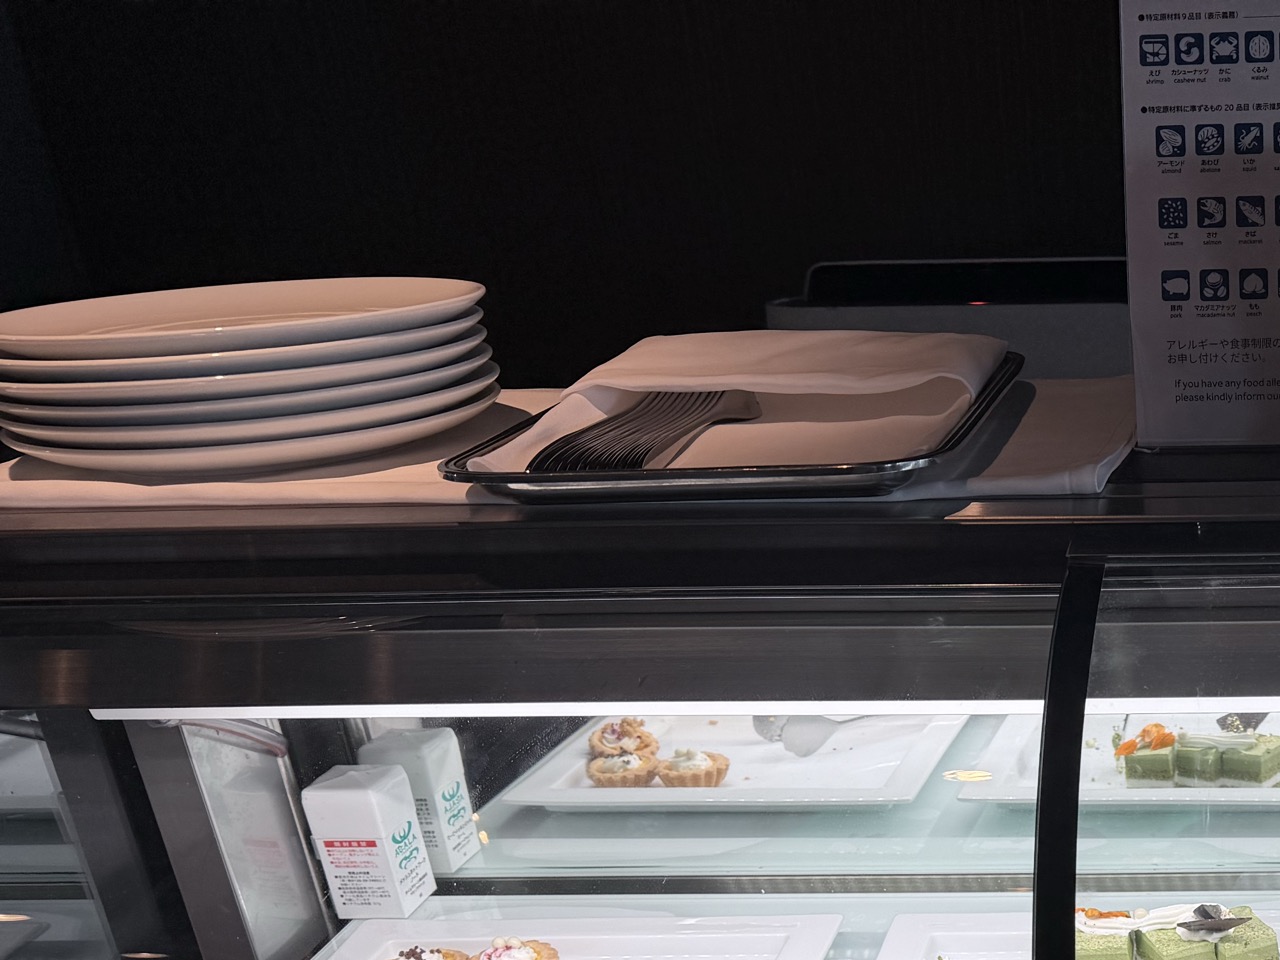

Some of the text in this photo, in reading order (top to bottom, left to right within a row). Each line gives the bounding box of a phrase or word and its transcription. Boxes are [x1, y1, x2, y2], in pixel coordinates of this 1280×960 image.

[1167, 353, 1266, 364] お申し付けください。
[1174, 379, 1182, 388] If
[1182, 381, 1200, 390] you
[1201, 380, 1223, 388] have
[1224, 381, 1242, 390] any
[1243, 378, 1265, 387] food
[1175, 392, 1205, 403] please
[1206, 392, 1233, 403] kindly
[1234, 391, 1265, 400] inform
